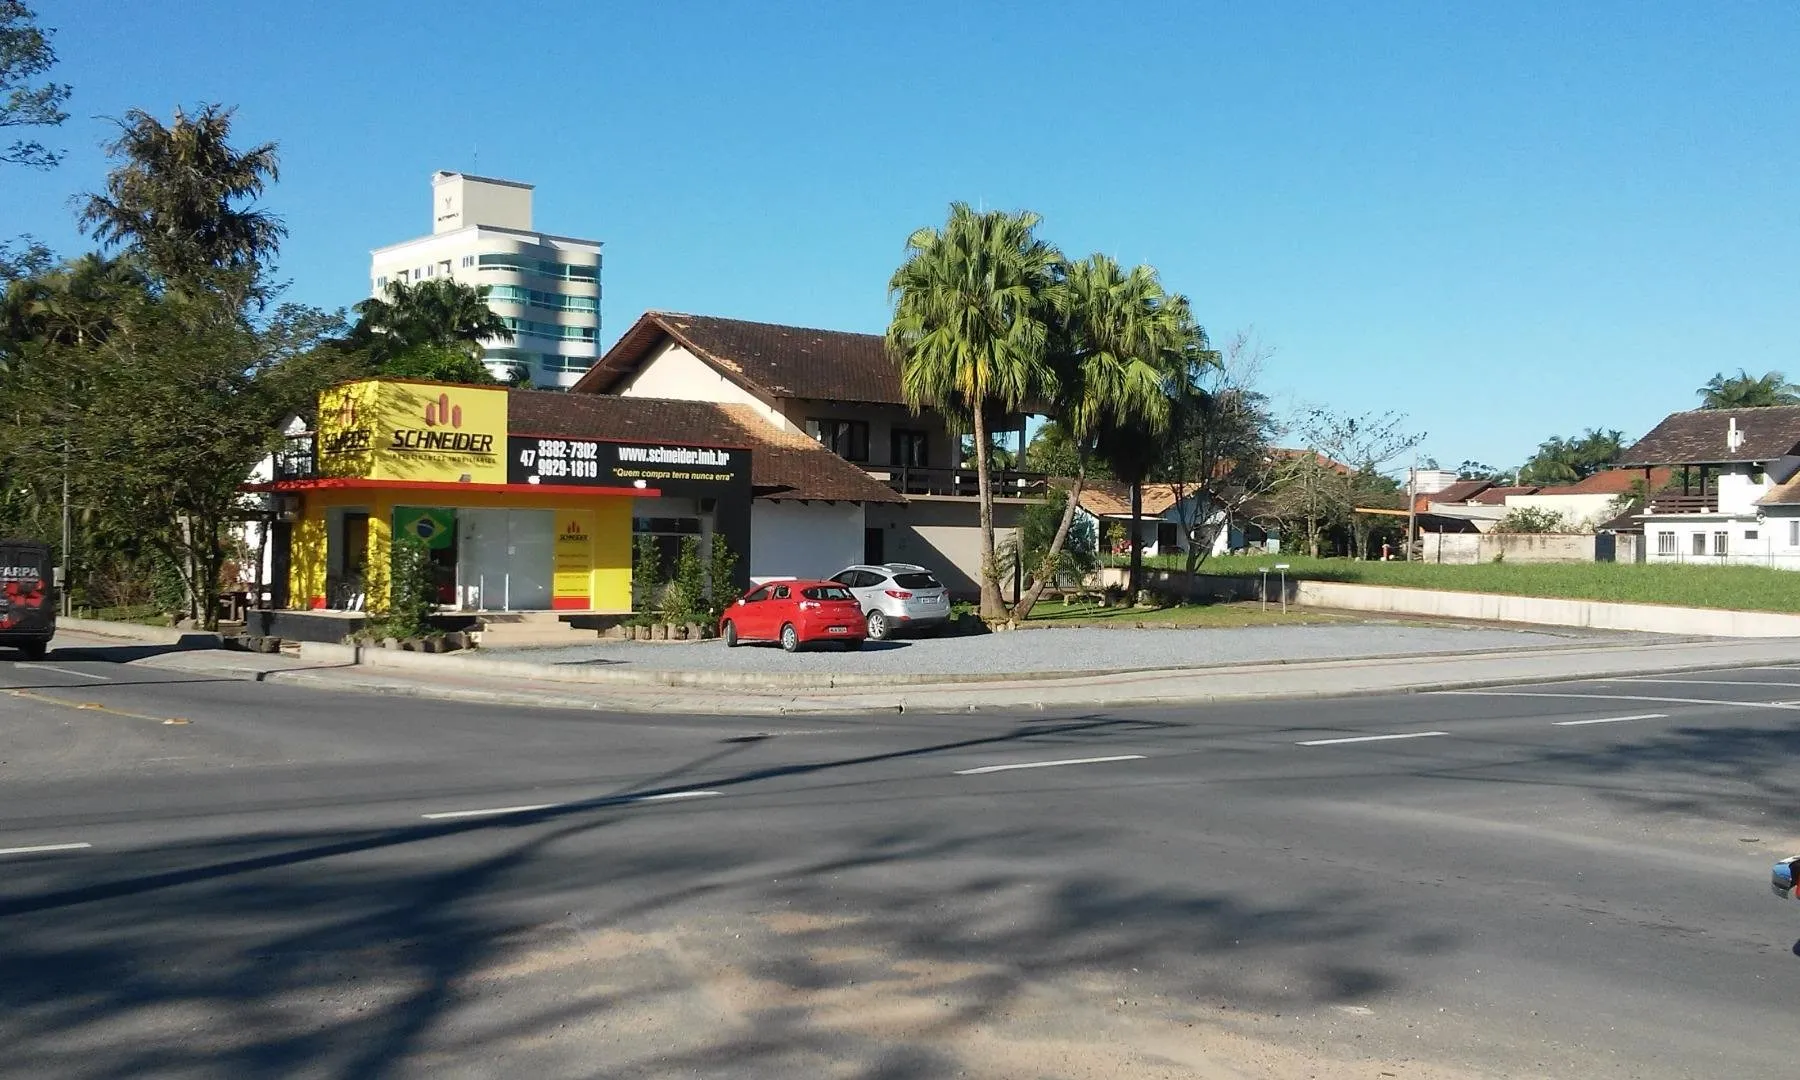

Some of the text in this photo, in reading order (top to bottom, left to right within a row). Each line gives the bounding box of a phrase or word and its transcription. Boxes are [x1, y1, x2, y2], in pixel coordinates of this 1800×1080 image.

[391, 429, 494, 452] SCHNEIDER
[538, 439, 598, 459] 3382-7302
[520, 449, 536, 467] 47
[618, 446, 731, 466] www.schneider.imb.br
[537, 458, 598, 478] 9929-1819
[641, 469, 671, 479] compra
[672, 470, 690, 480] terra
[691, 472, 714, 481] nunca
